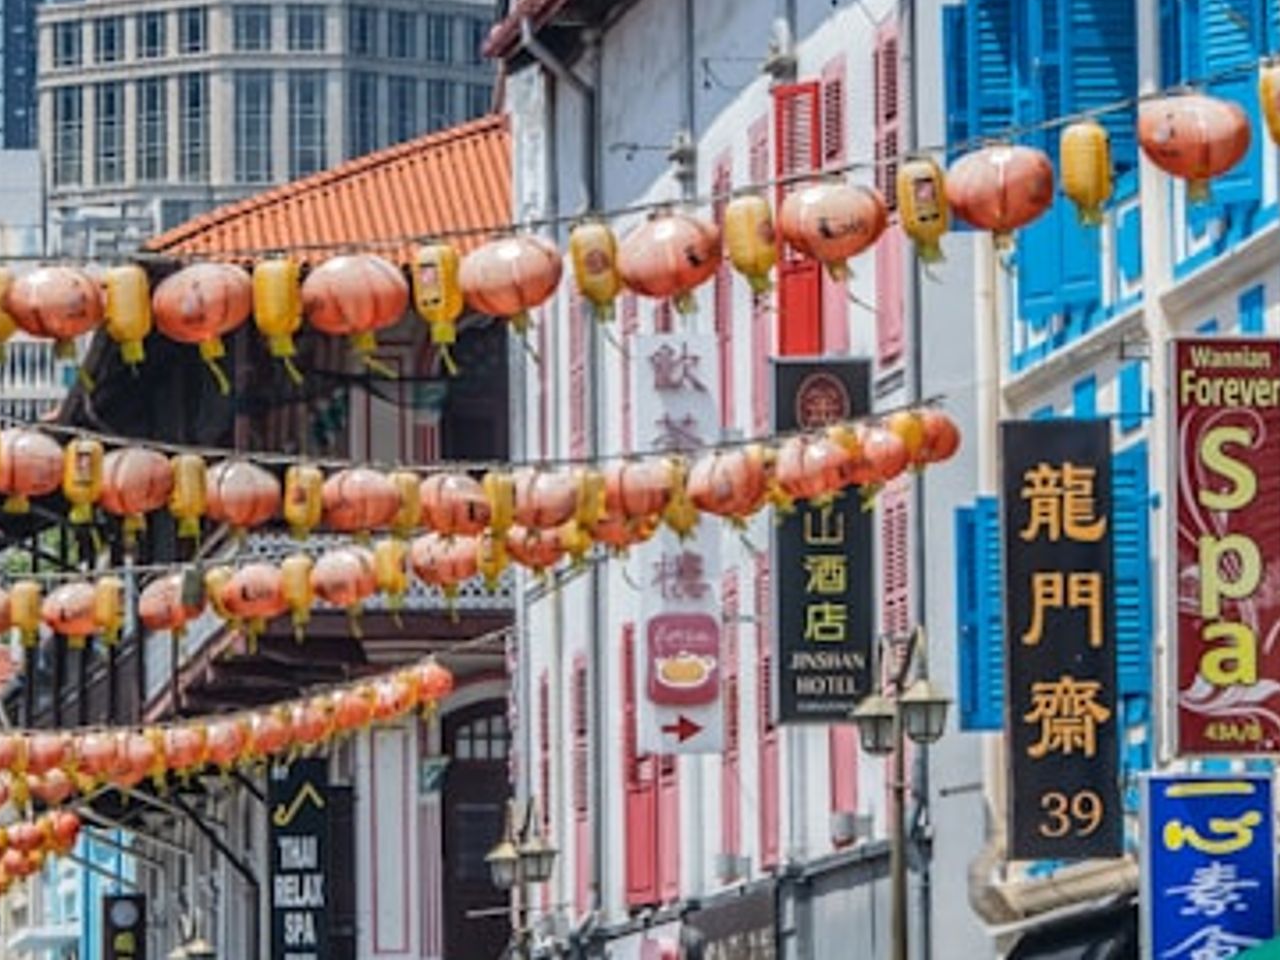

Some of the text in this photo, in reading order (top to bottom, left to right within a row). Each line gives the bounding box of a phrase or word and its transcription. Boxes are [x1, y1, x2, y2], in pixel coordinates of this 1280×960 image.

[1181, 369, 1280, 407] Forever
[1197, 426, 1262, 685] Spa
[795, 673, 858, 697] HOTEL
[1039, 791, 1105, 838] 39
[274, 874, 324, 908] RELAX
[283, 911, 316, 945] SPA
